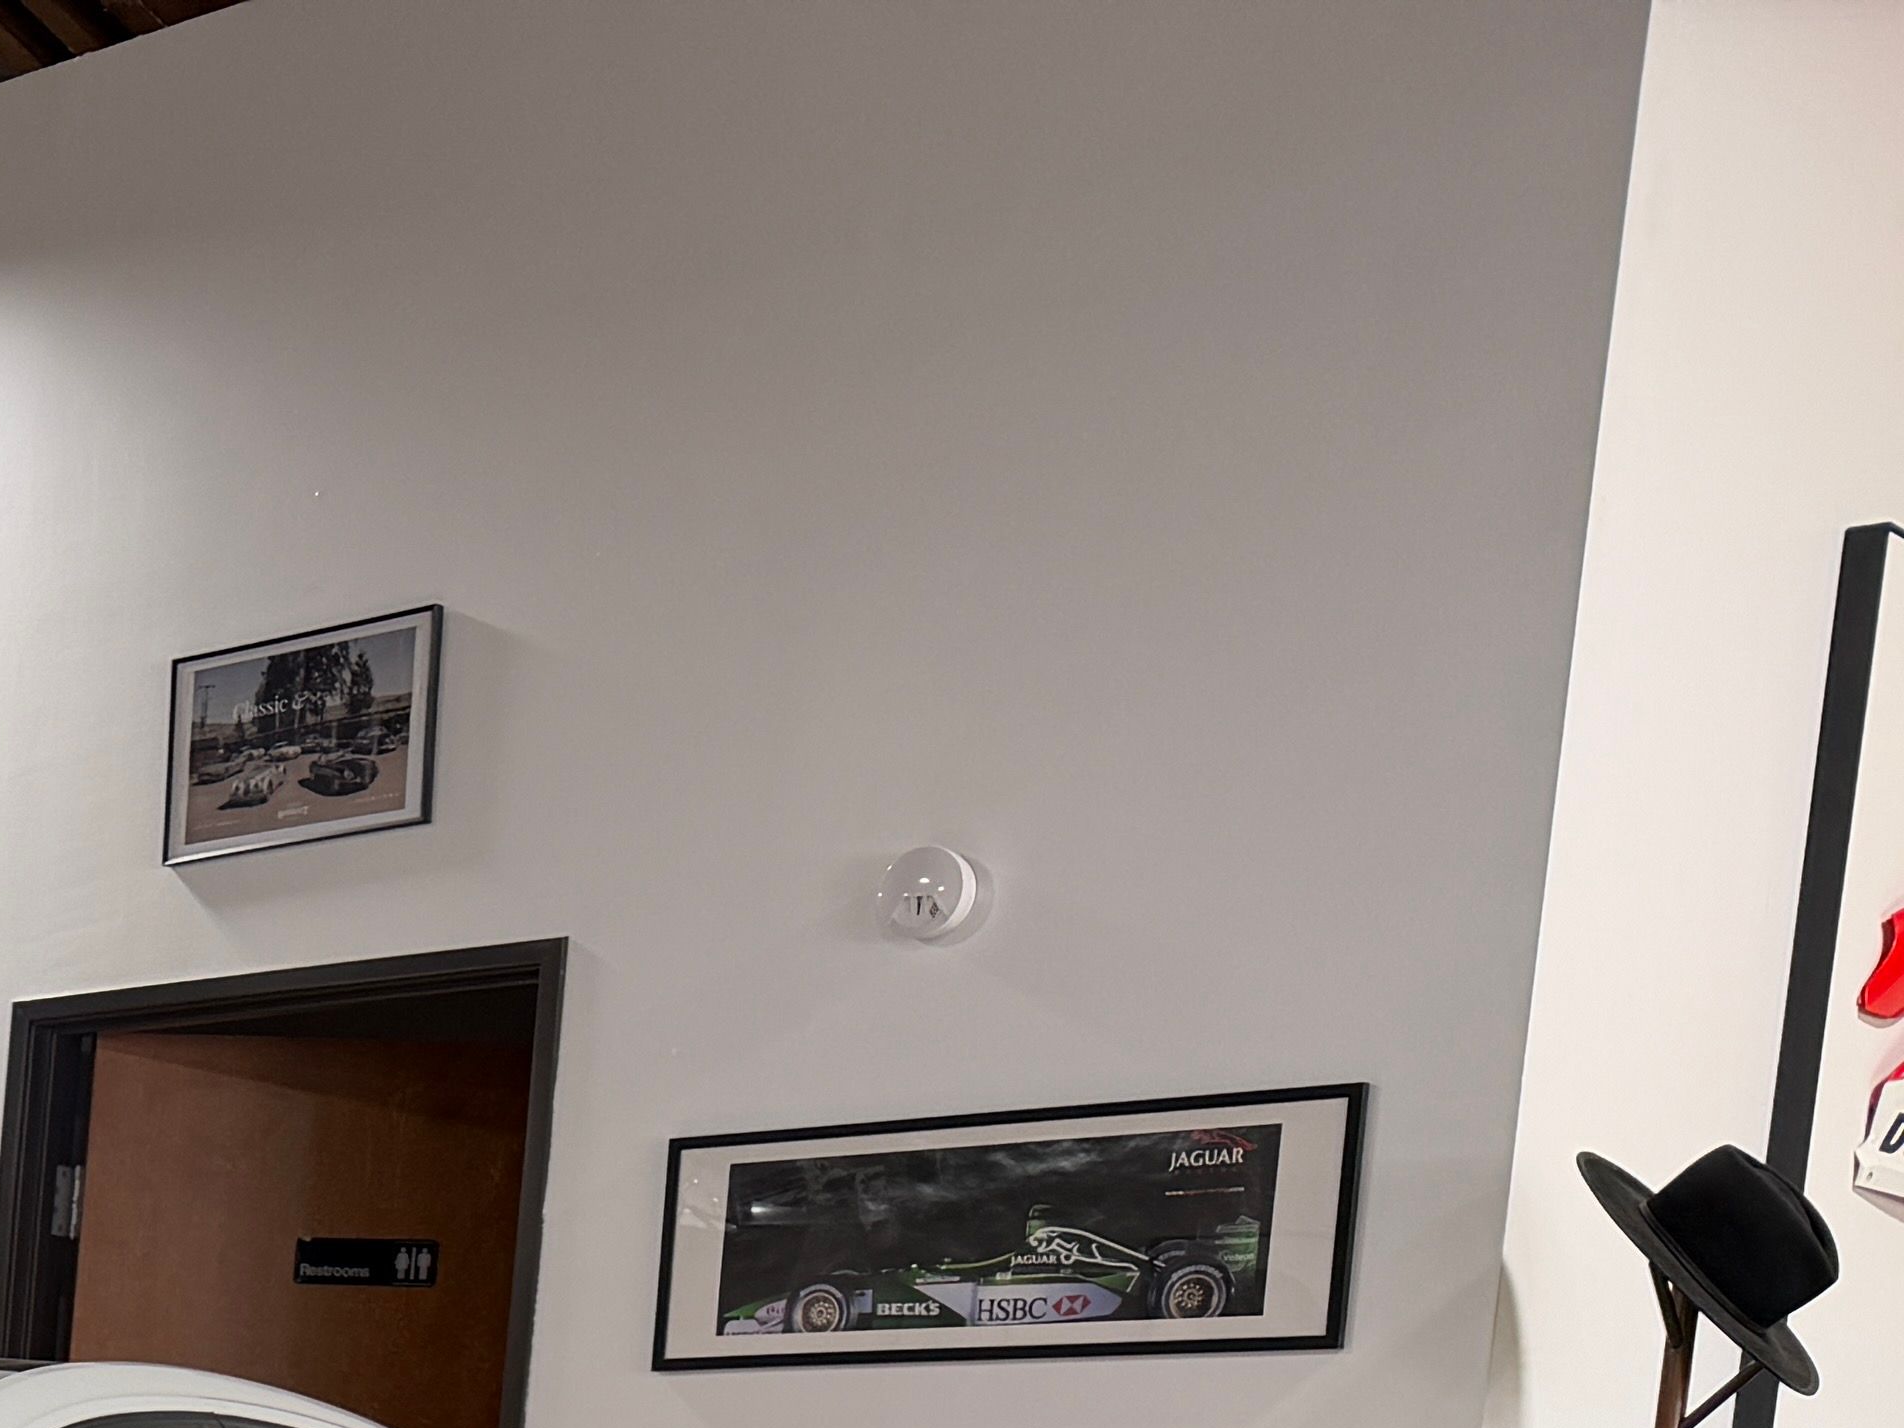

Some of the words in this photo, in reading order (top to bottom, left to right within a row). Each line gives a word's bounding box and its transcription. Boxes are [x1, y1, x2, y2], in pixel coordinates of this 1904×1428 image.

[232, 694, 288, 723] Classic
[1168, 1146, 1243, 1172] JAGUAR
[299, 1263, 370, 1278] Restrooms
[1010, 1252, 1058, 1266] JAGUAR
[977, 1297, 1048, 1322] HSBC
